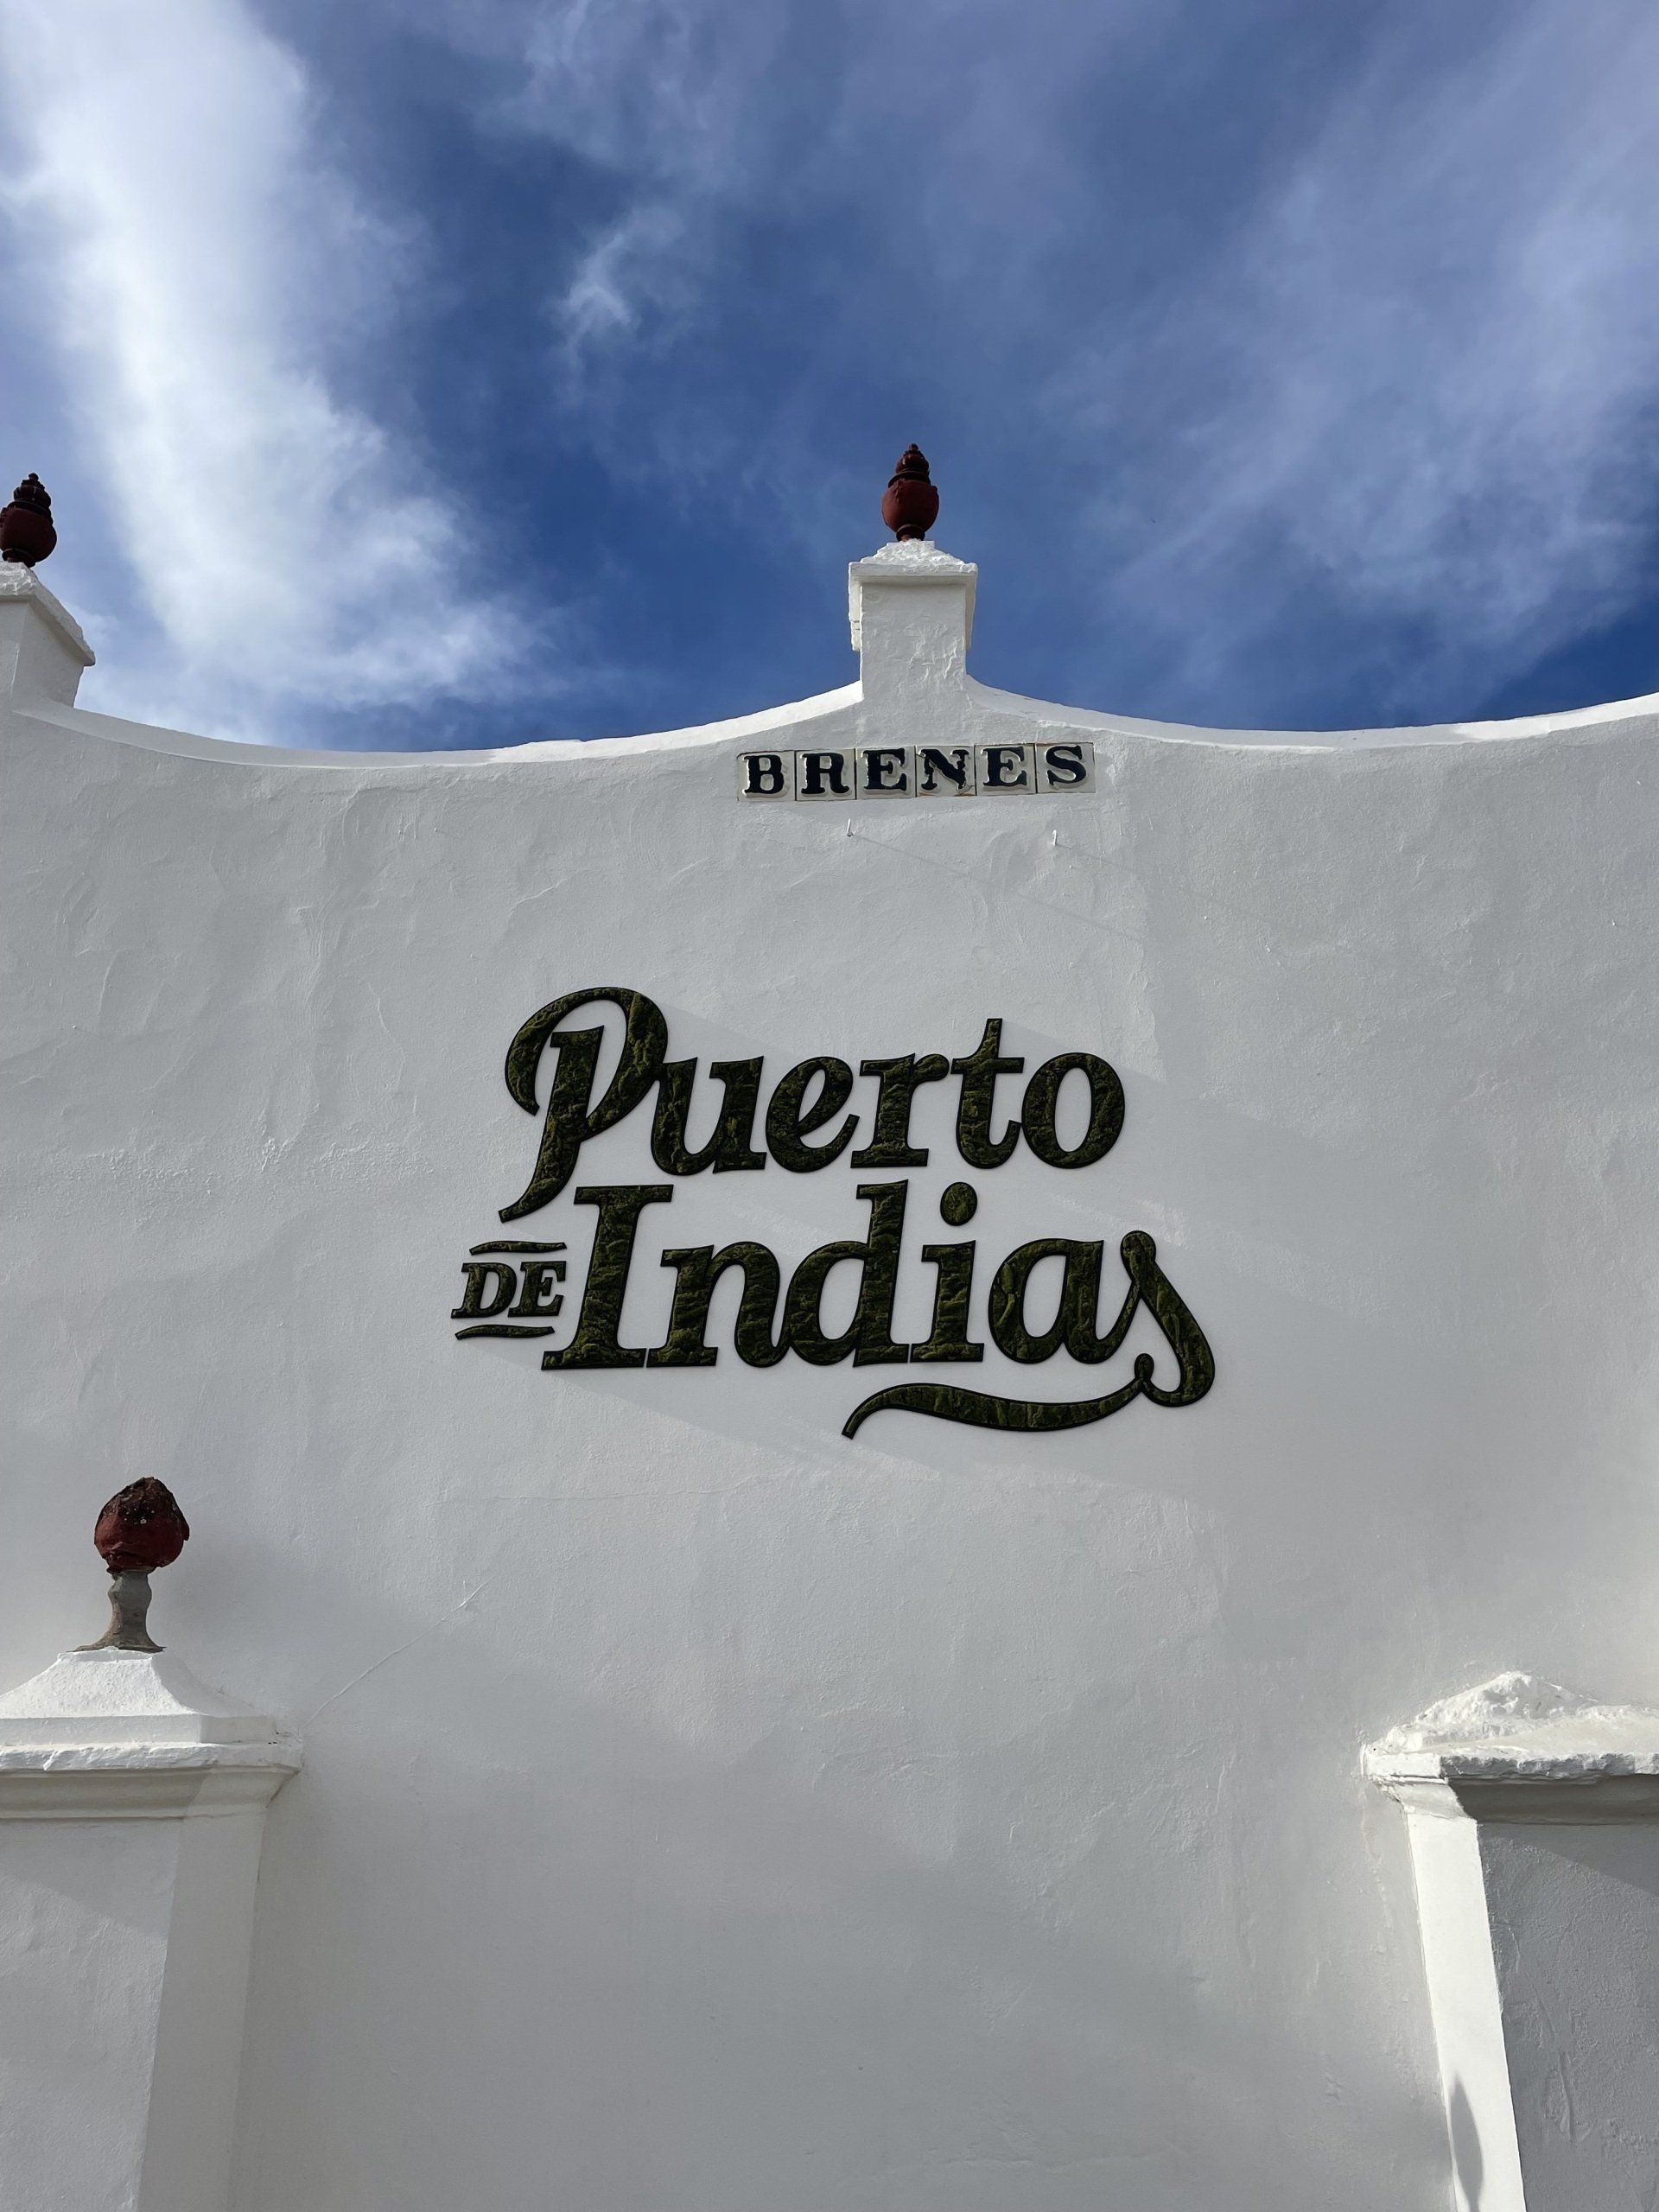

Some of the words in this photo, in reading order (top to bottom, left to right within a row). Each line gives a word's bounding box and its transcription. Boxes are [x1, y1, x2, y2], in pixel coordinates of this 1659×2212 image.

[742, 744, 1088, 796] BRENES
[497, 986, 1126, 1224] Puerto
[450, 1260, 568, 1320] DE
[540, 1179, 1216, 1440] Indias
